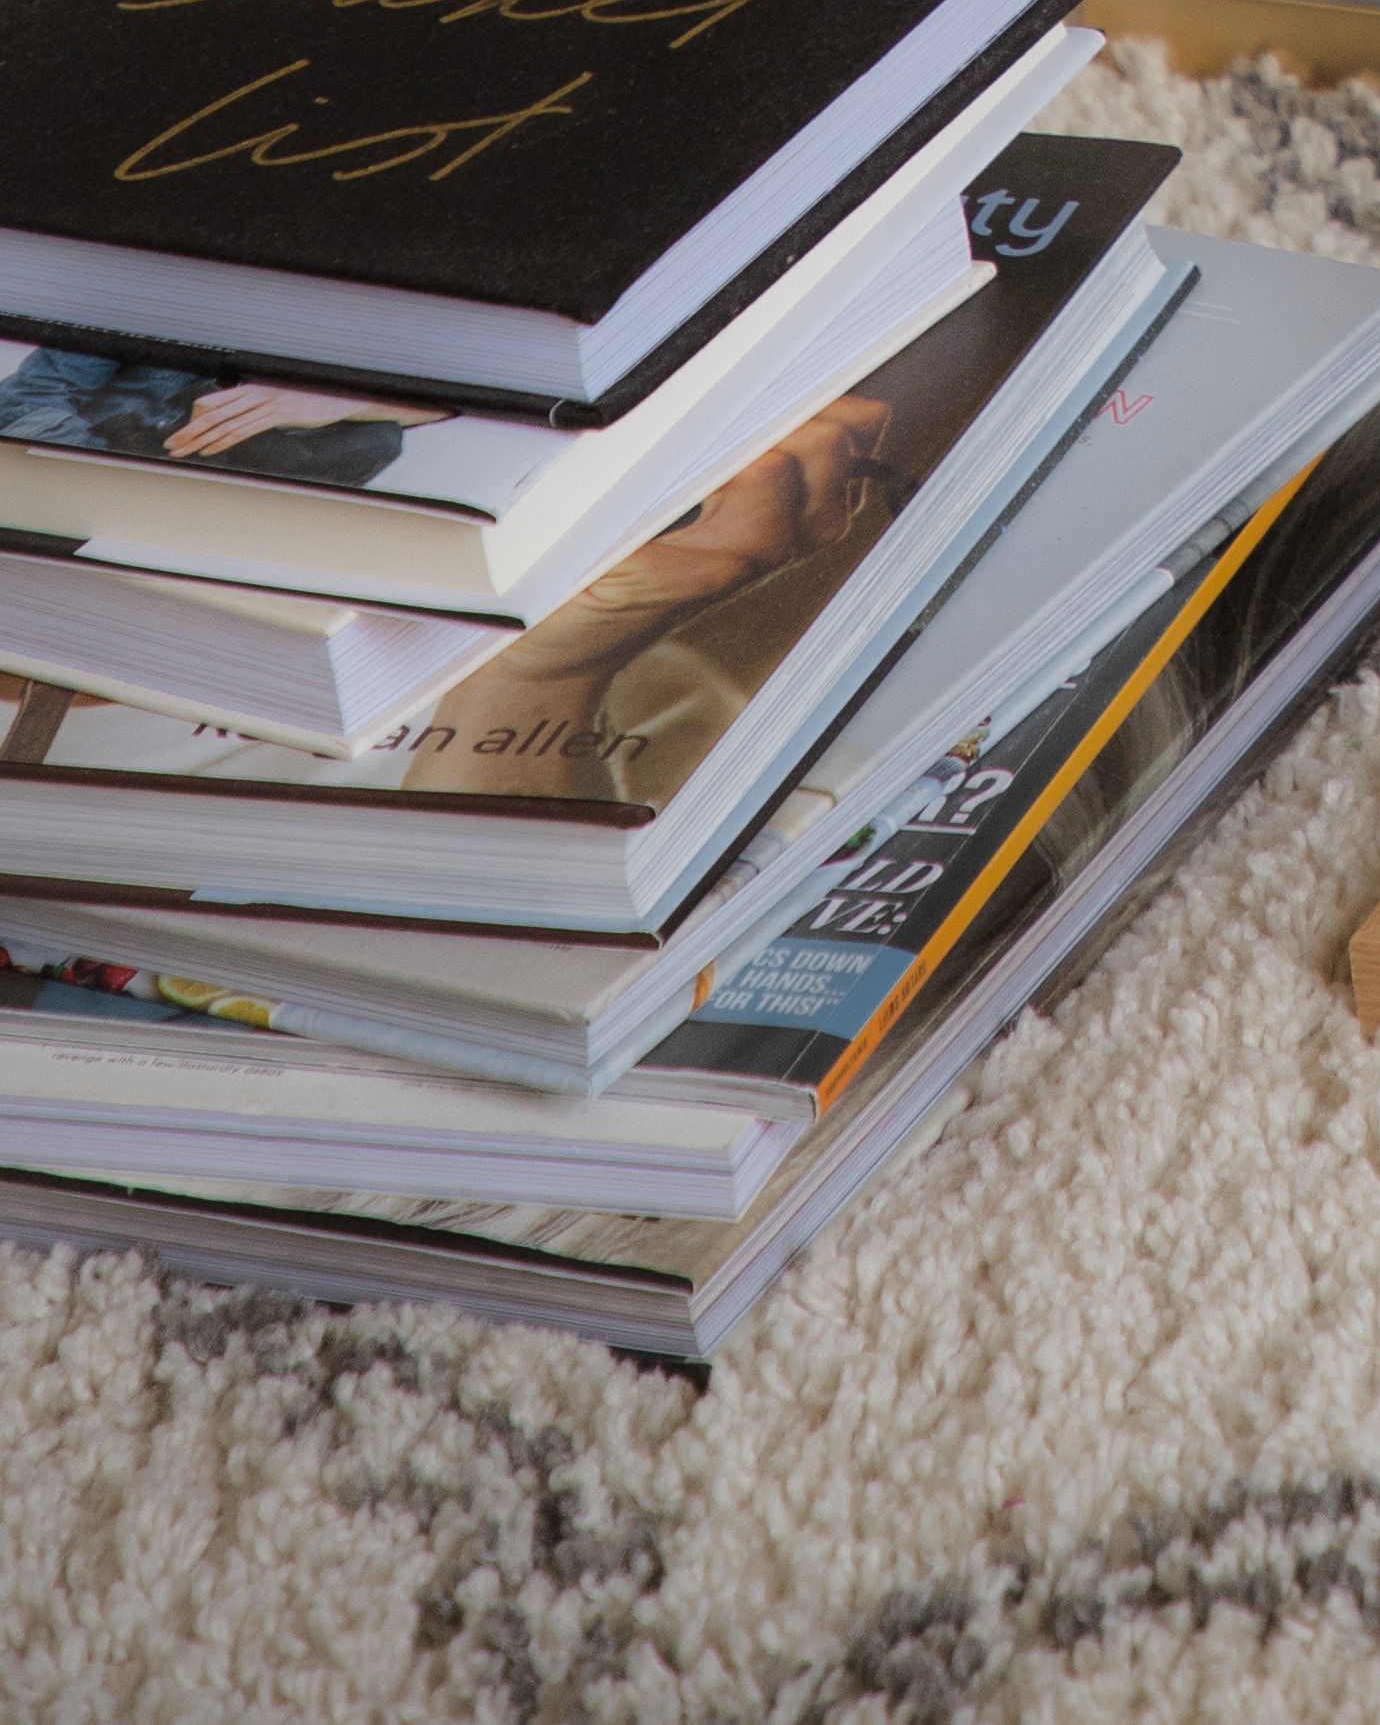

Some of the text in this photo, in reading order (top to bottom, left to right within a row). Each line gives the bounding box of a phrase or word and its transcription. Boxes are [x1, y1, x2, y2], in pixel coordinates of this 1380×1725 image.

[962, 188, 1080, 257] ty
[473, 719, 650, 763] allen
[791, 951, 874, 974] DOWN
[107, 1054, 134, 1065] with
[151, 1058, 175, 1069] few
